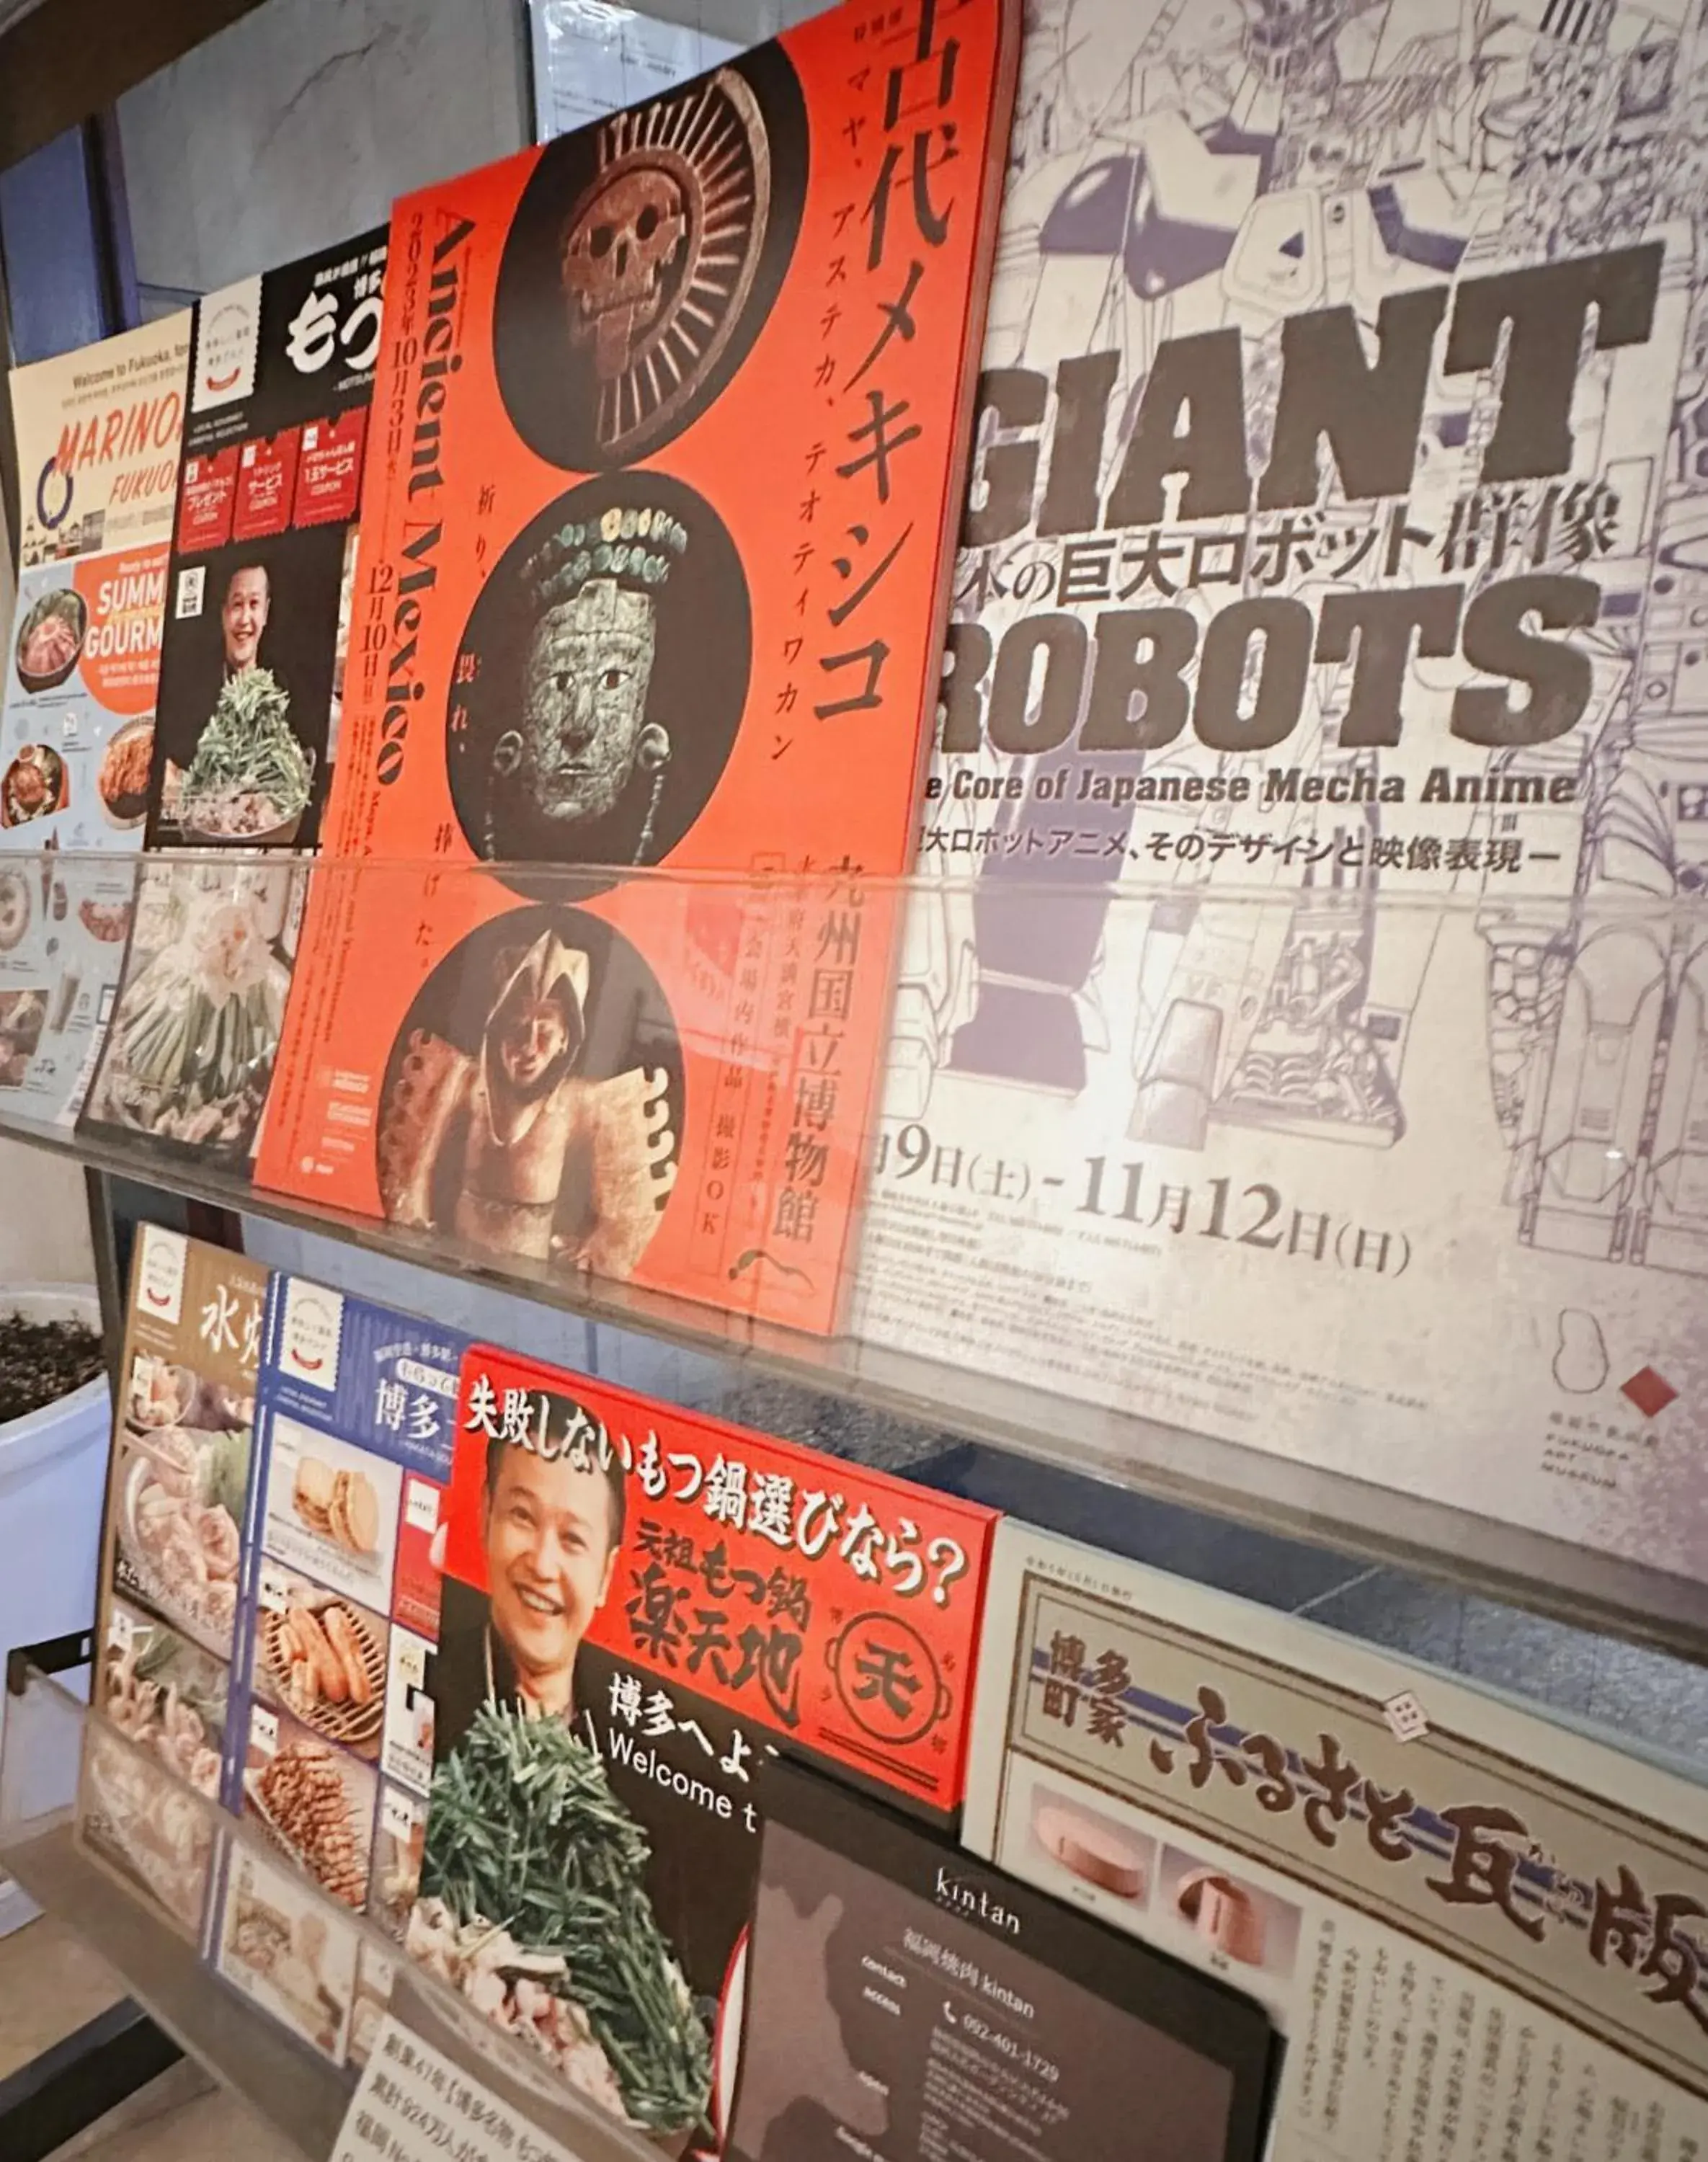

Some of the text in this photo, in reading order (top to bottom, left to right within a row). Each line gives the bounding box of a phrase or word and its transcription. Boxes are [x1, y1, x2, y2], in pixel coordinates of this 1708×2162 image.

[73, 368, 115, 390] Welcome
[285, 291, 384, 373] もつ
[813, 0, 971, 721] 古代メキシコ
[958, 239, 1666, 549] GIANT
[373, 208, 479, 786] Ancient Mexico
[938, 575, 1603, 754] ROBOTS
[952, 770, 1022, 803] Core
[1035, 769, 1070, 802] of
[1076, 769, 1250, 809] Japanese
[1263, 766, 1404, 804] Mecha
[1421, 766, 1575, 804] Anime
[771, 854, 865, 1245] 九州国立博物館
[463, 1373, 966, 1603] 失敗しないもつ鍋選びなら?
[633, 1518, 812, 1632] 元祖もつ鍋
[626, 1562, 801, 1728] 楽天地
[1050, 1629, 1131, 1696] 博多
[609, 1672, 779, 1782] 博多へよ
[1042, 1681, 1127, 1748] 町家
[610, 1727, 732, 1818] Welcome
[937, 1866, 1020, 1934] kintan
[982, 1975, 1036, 2019] kintan
